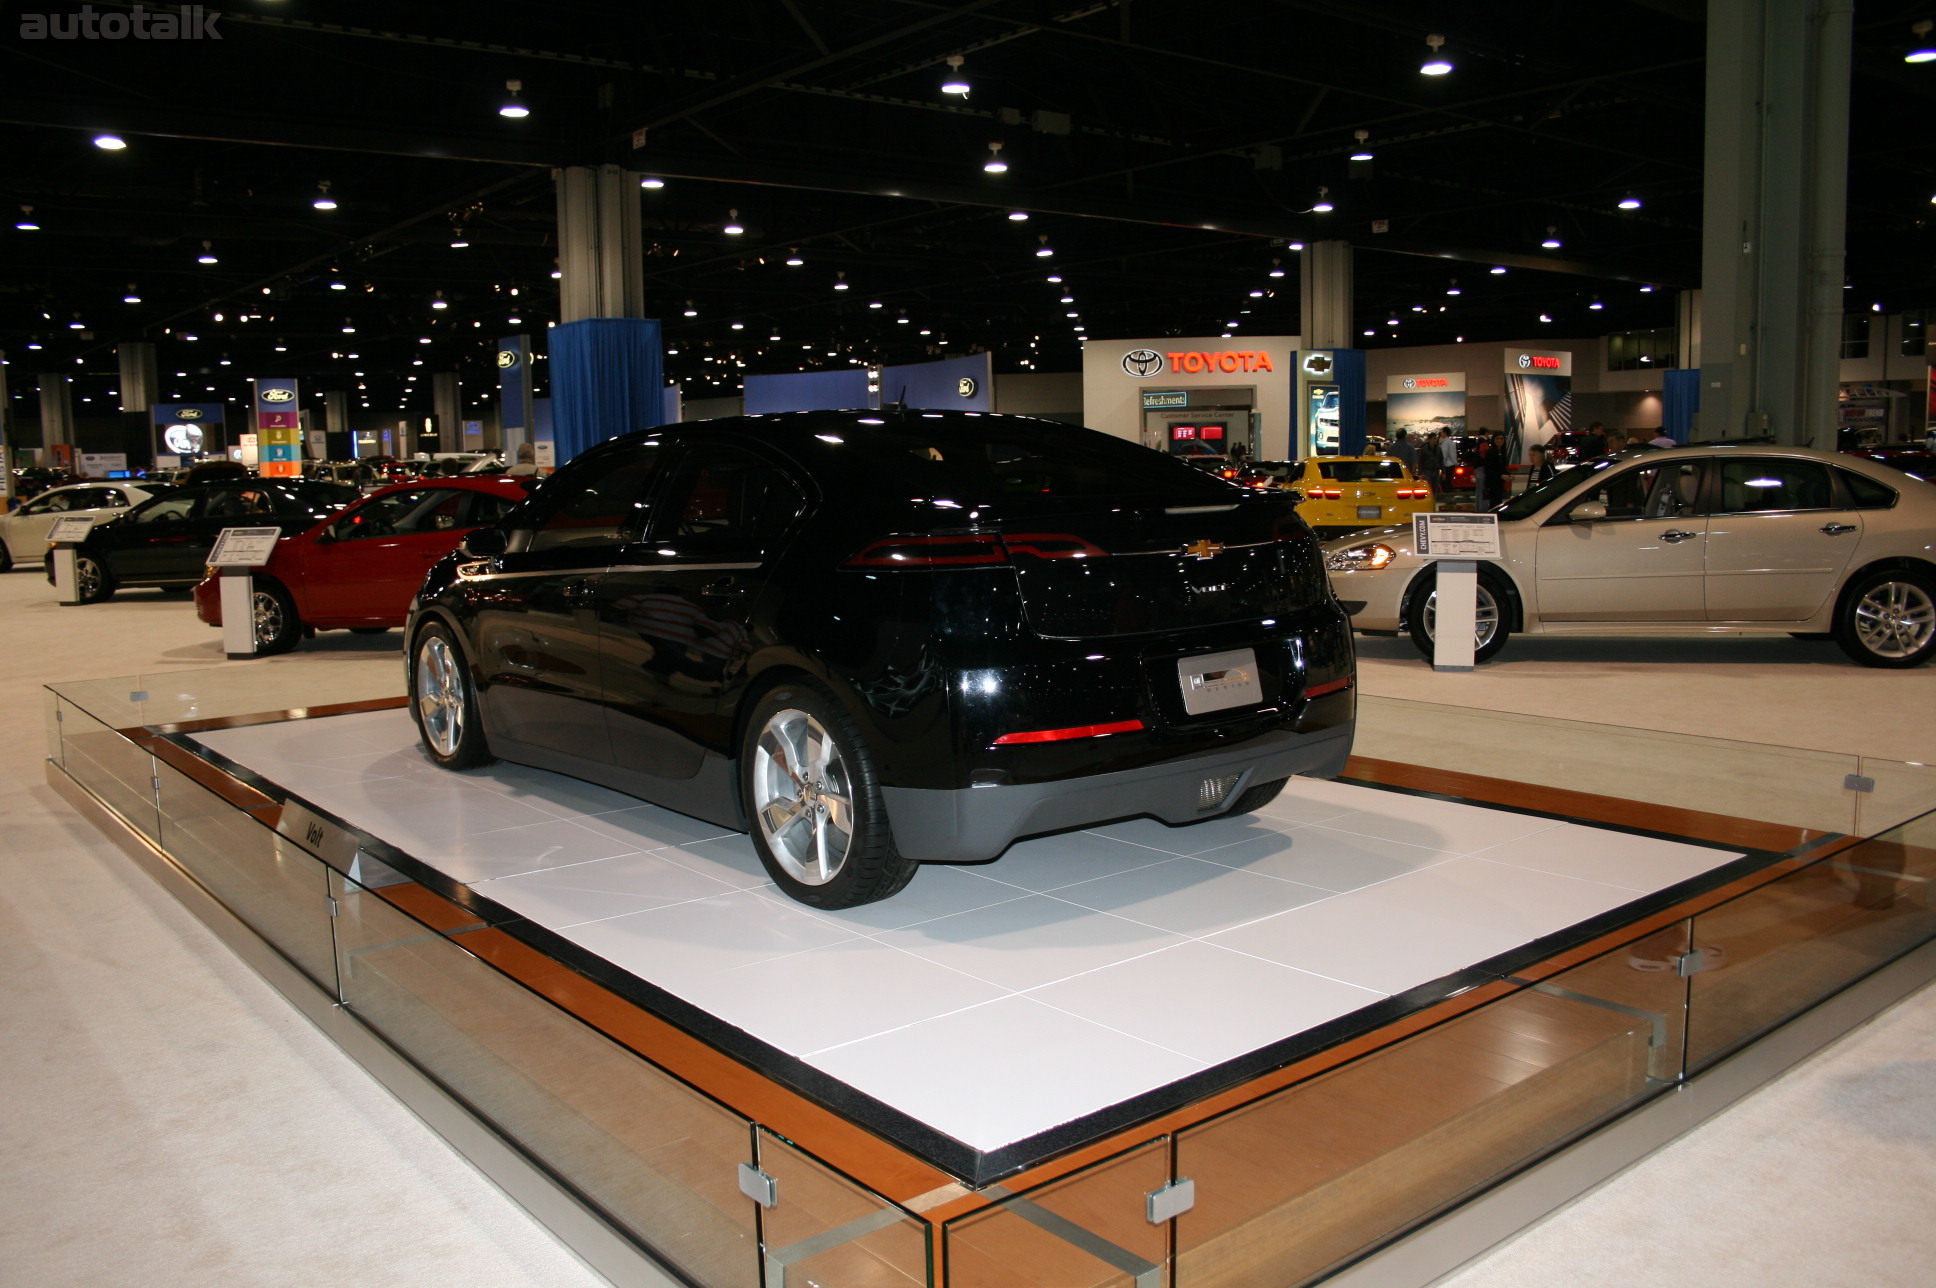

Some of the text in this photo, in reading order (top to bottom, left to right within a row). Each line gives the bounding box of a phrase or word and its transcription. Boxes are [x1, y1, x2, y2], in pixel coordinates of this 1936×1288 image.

[1167, 351, 1274, 373] TOYOTA
[1532, 356, 1561, 368] TOYOTA
[1415, 378, 1449, 387] TOYOTA
[266, 388, 291, 401] Ford
[1419, 519, 1427, 550] CHEVY.COM
[306, 821, 324, 848] Volt
